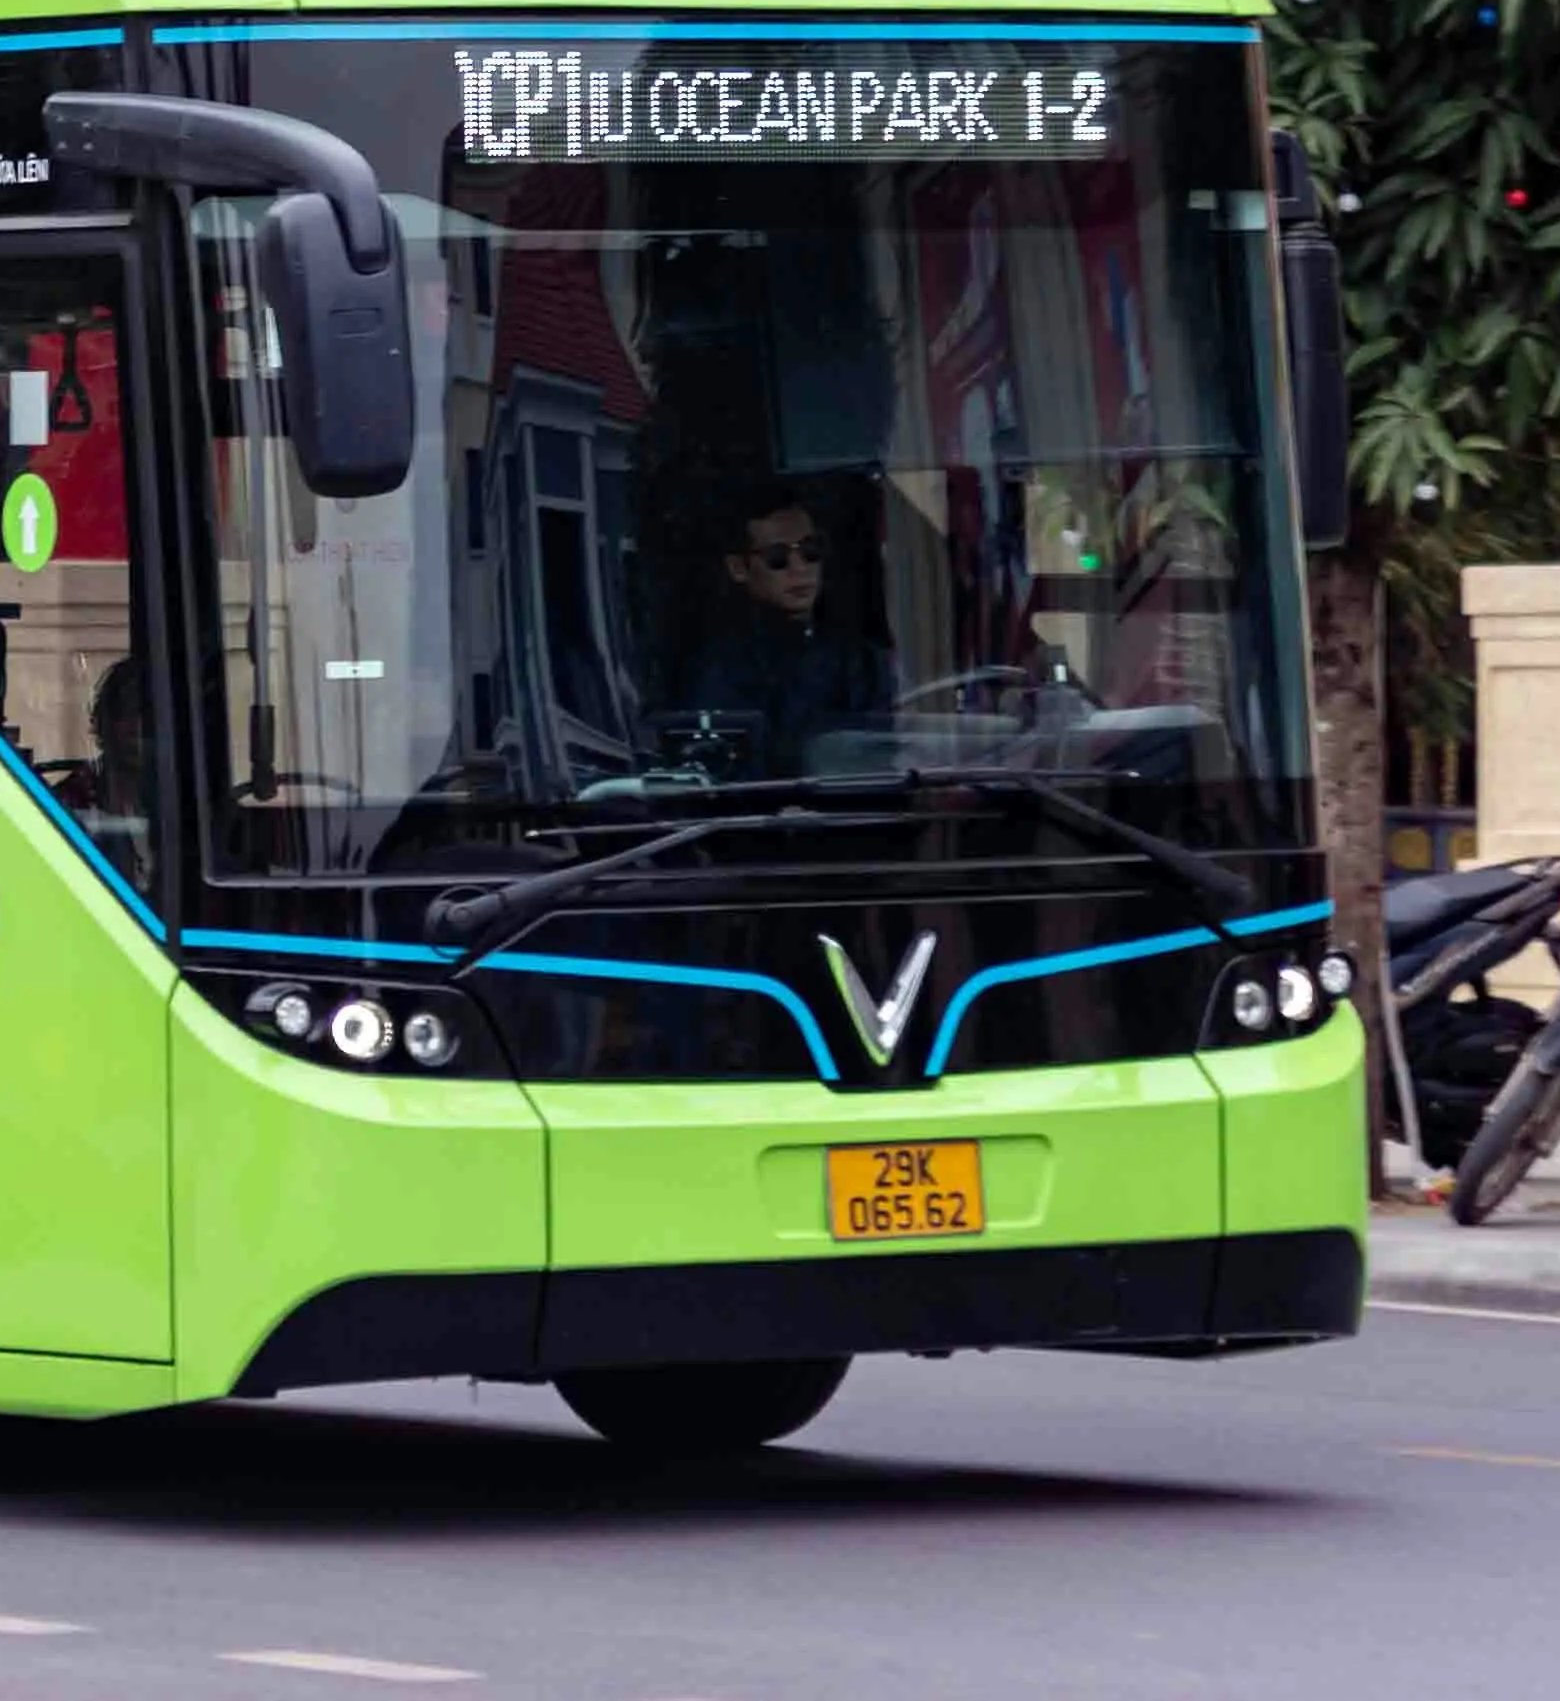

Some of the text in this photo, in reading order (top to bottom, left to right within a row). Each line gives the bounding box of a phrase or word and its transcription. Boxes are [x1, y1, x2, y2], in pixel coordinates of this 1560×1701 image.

[650, 71, 836, 142] OCEAN
[851, 71, 998, 142] PARK
[1023, 71, 1108, 142] 1-2
[17, 152, 49, 184] LÊN
[873, 1149, 939, 1188] 29K
[848, 1190, 968, 1233] 065.62
